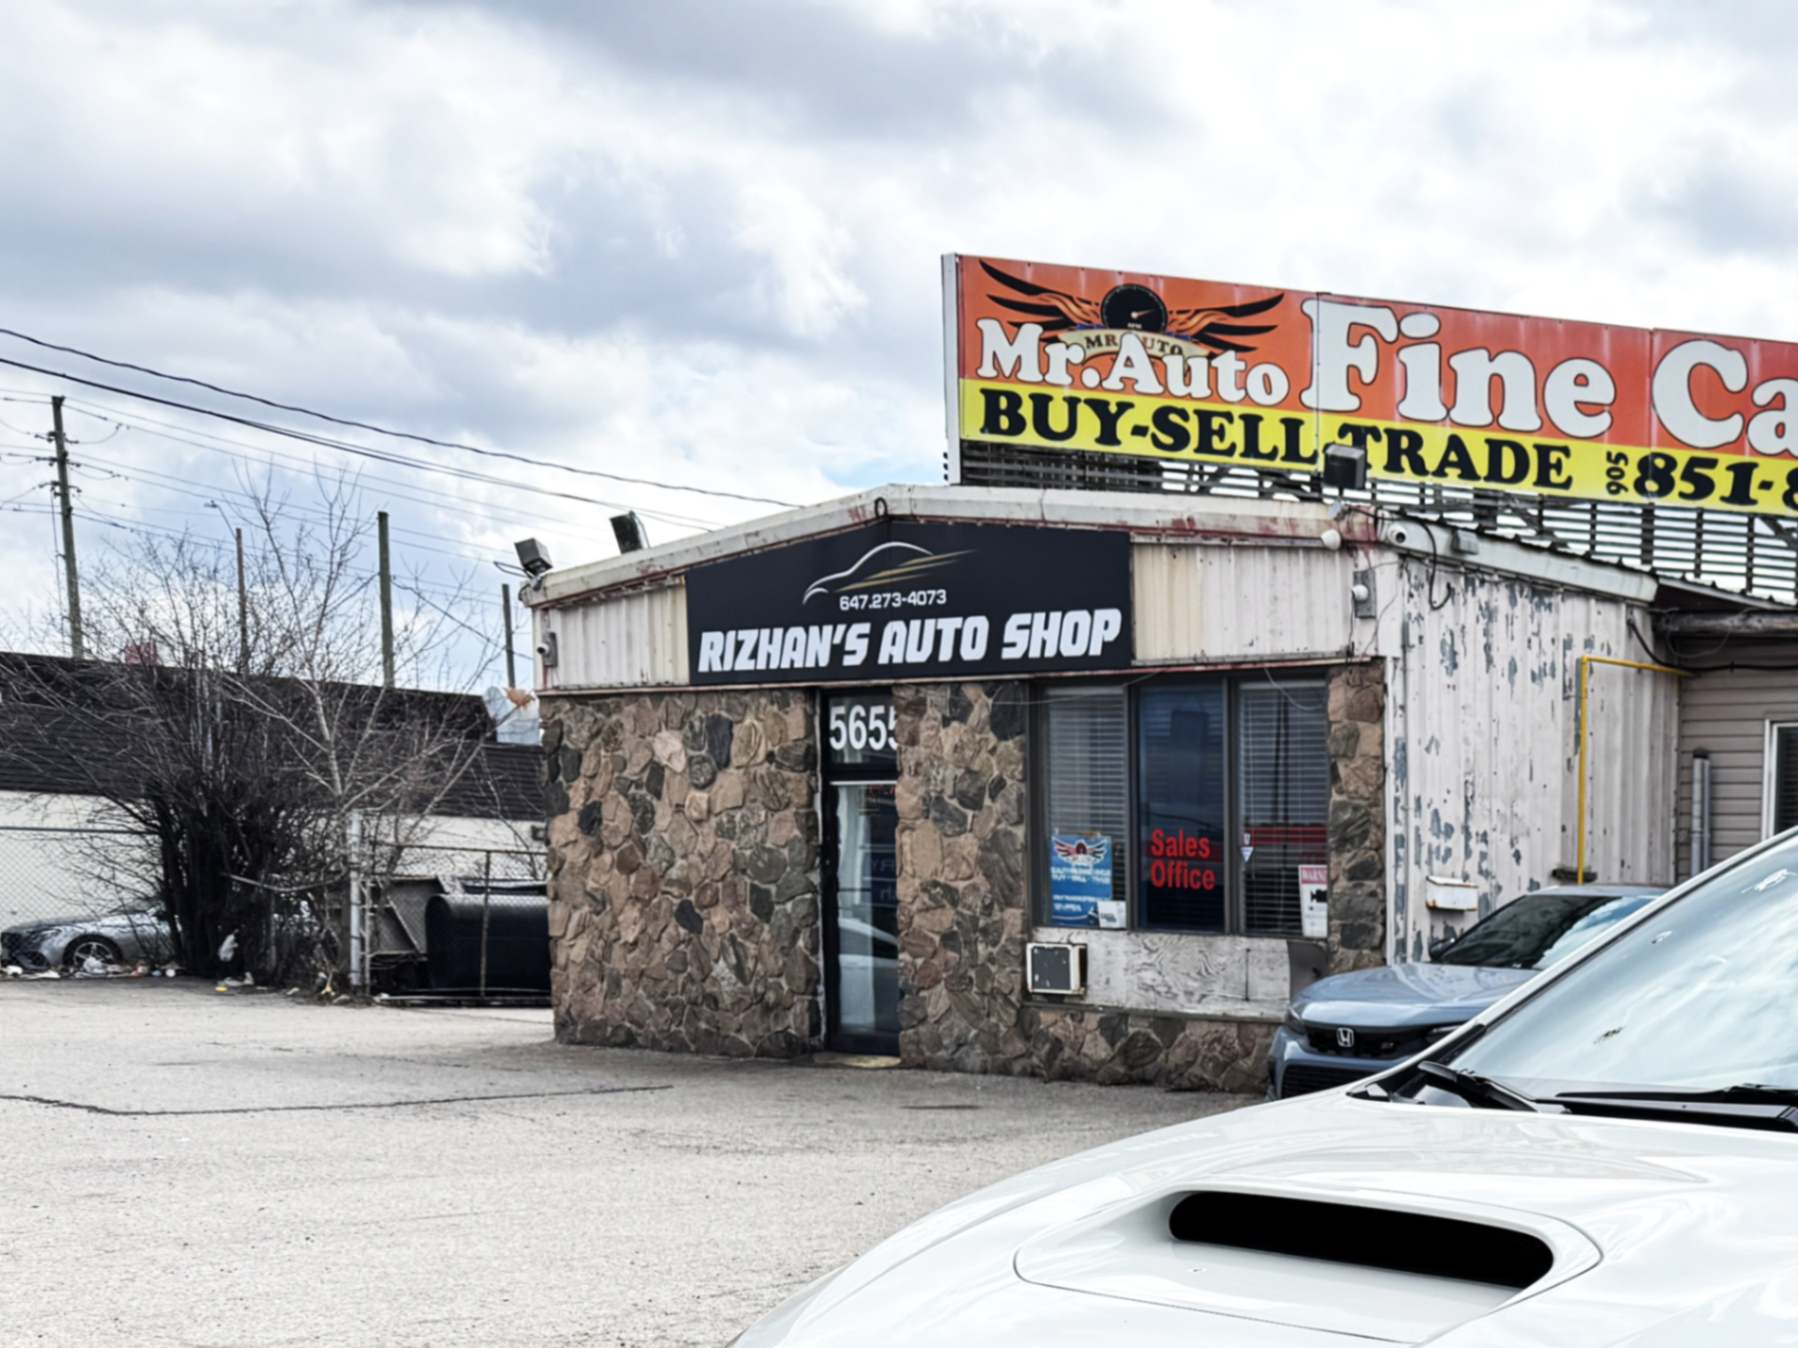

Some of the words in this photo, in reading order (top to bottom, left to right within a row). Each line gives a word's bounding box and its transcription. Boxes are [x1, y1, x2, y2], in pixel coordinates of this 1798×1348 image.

[976, 317, 1289, 406] Mr.Auto
[1300, 299, 1617, 438] Fine
[1606, 450, 1629, 495] 905
[697, 621, 873, 674] RIZHAN'S
[877, 615, 991, 666] AUTO
[1000, 607, 1124, 661] SHOP
[1151, 828, 1211, 859] Sales
[1151, 859, 1216, 891] Office
